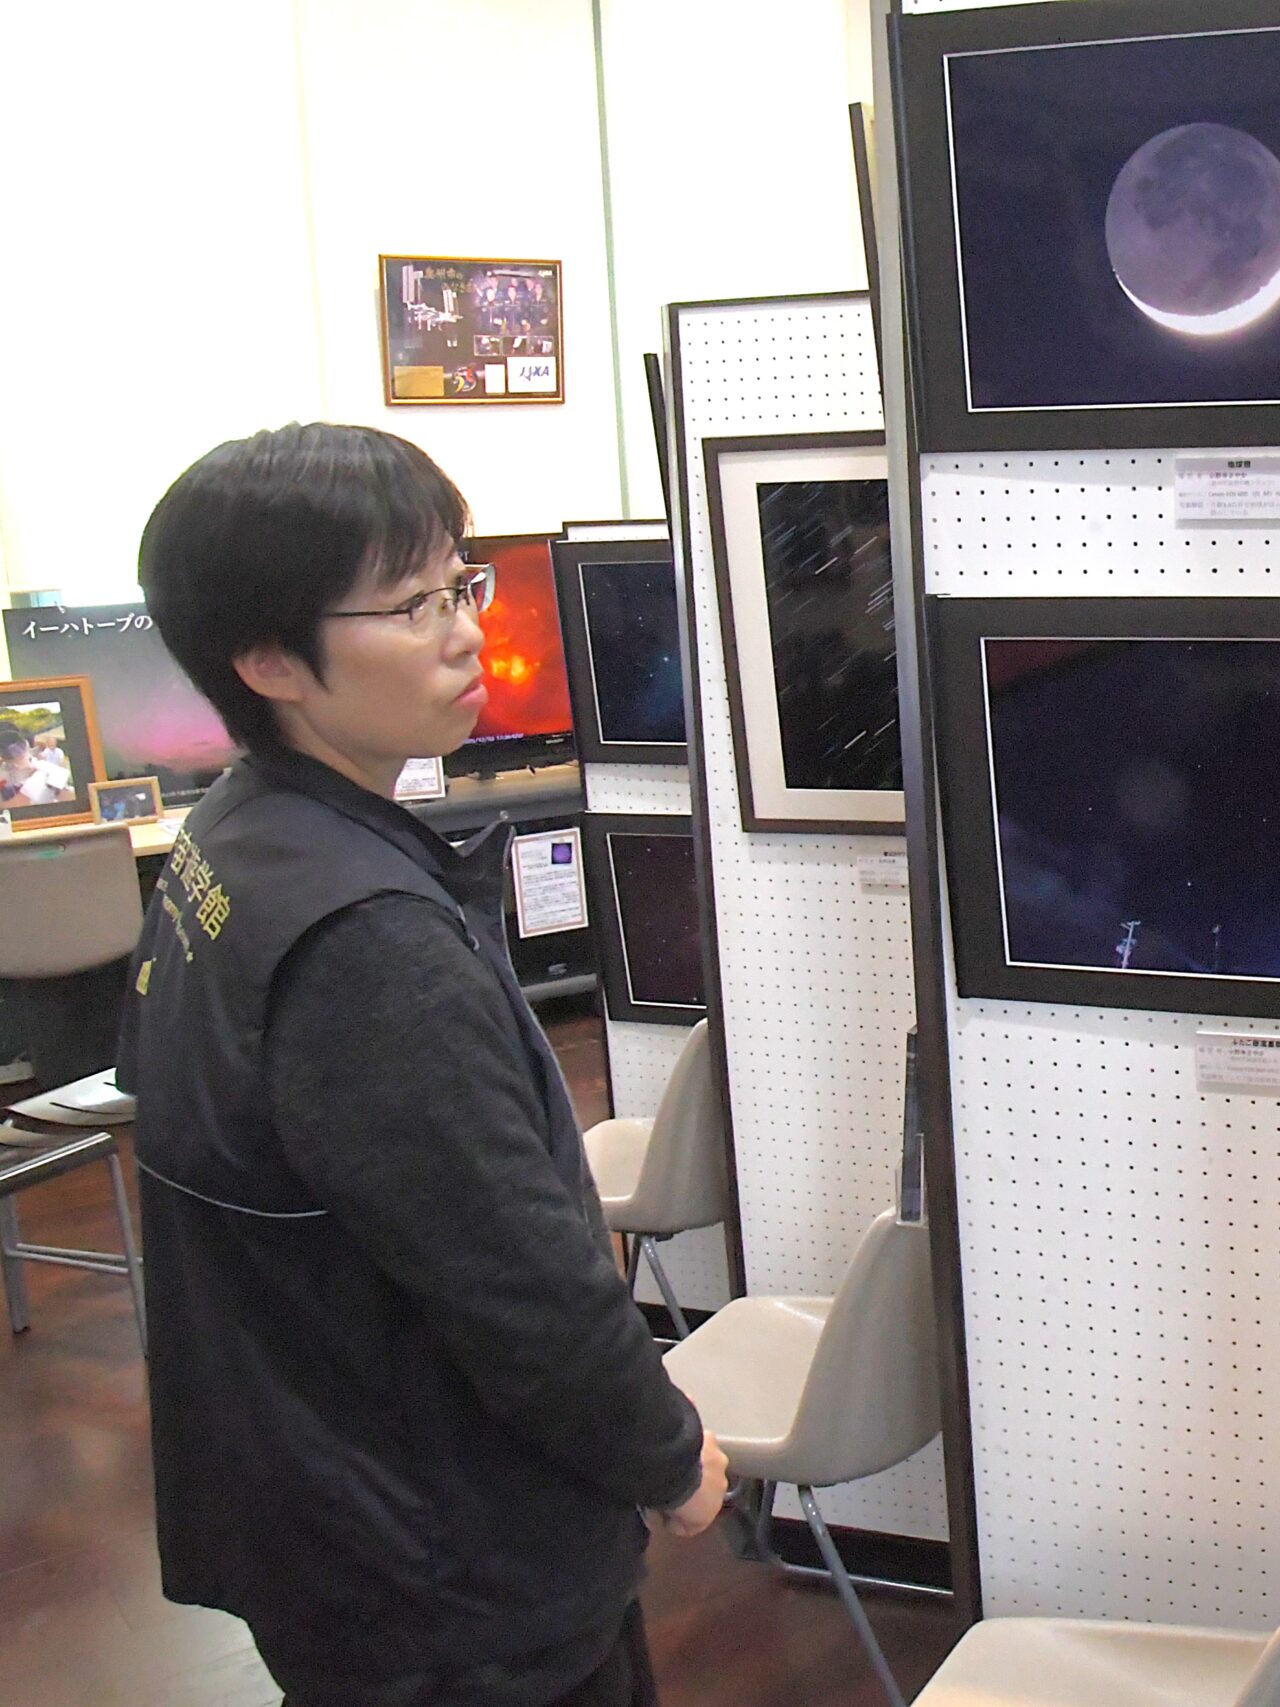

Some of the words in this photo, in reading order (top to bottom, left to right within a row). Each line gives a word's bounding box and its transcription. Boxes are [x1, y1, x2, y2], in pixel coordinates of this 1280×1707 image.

[22, 612, 154, 639] イーハトーブの
